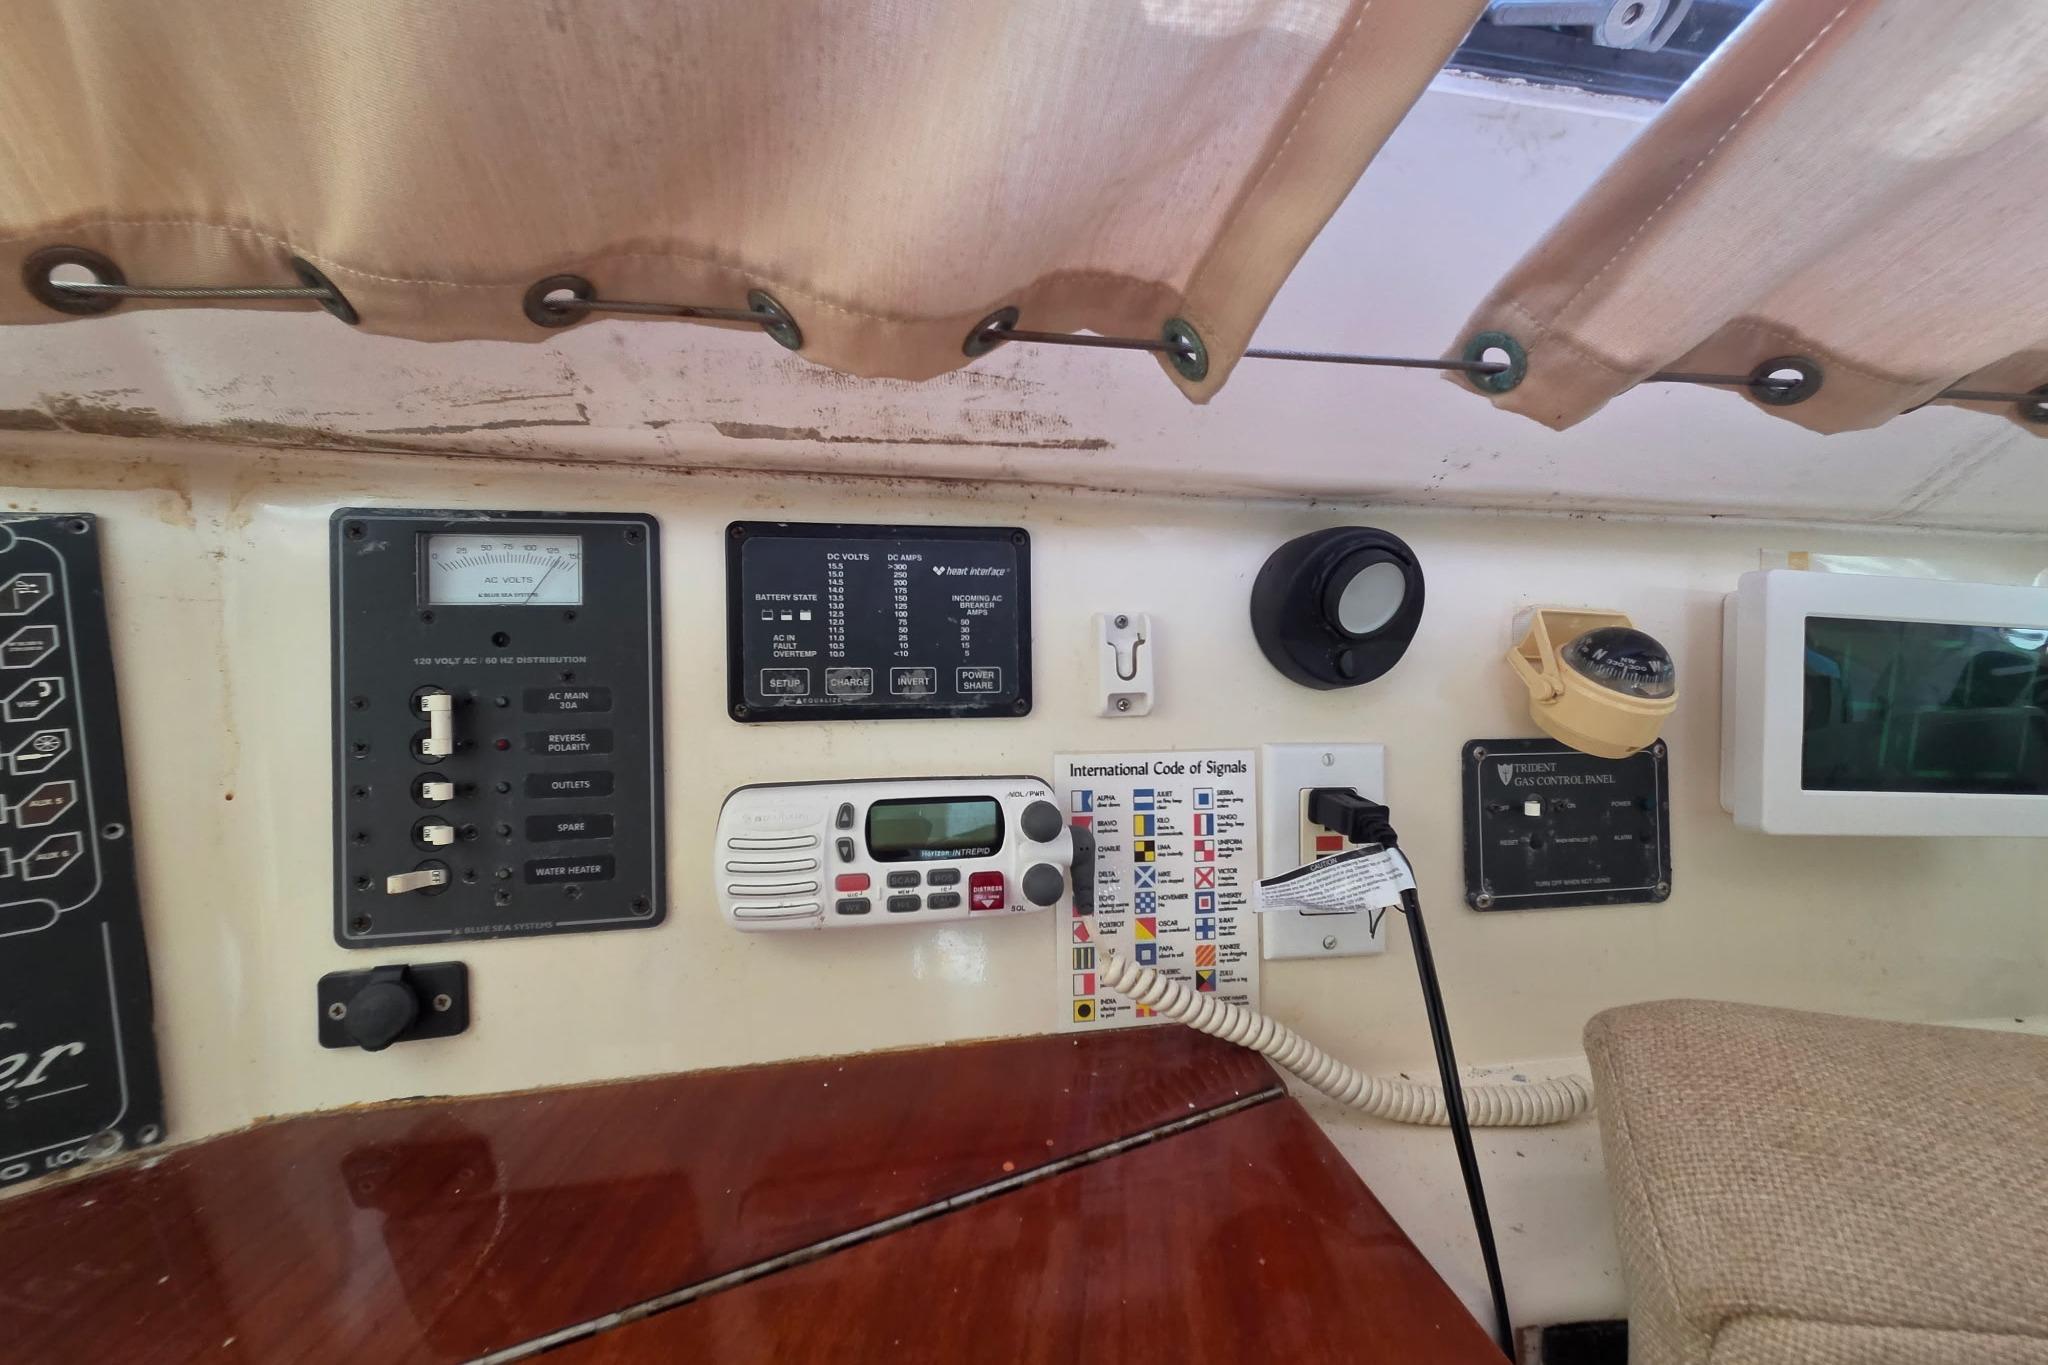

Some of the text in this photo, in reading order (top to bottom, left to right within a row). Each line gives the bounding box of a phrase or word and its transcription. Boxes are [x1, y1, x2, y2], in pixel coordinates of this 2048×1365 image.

[456, 546, 467, 555] 25
[480, 544, 493, 552] 50
[503, 543, 514, 551] 75
[523, 544, 538, 552] 100
[545, 547, 560, 555] 125
[827, 553, 870, 561] DC VOLTS
[946, 566, 1006, 576] heart interface
[484, 576, 534, 584] AC VOLTS
[773, 650, 817, 658] OVERTEMP
[413, 657, 432, 665] 120
[434, 657, 460, 665] VOLT
[463, 657, 477, 665] AC
[485, 656, 498, 665] 60
[500, 656, 514, 664] HZ
[516, 656, 587, 664] DISTRIBUTION
[769, 679, 801, 687] SETUP
[830, 678, 869, 686] CHARGE
[897, 677, 929, 686] INVERT
[963, 682, 994, 690] SHARE
[548, 692, 589, 700] AC MAIN
[548, 733, 586, 742] REVERSE
[548, 743, 591, 752] POLARITY
[1070, 760, 1247, 777] International Code of Signals
[1514, 763, 1557, 773] TRIDENT
[1514, 774, 1616, 786] GAS CONTROL PANEL
[551, 781, 592, 789] OUTLETS
[557, 823, 585, 831] SPARE
[952, 847, 990, 856] INTREPID
[1310, 858, 1338, 872] CAUTION
[536, 865, 601, 876] WATER HEATER
